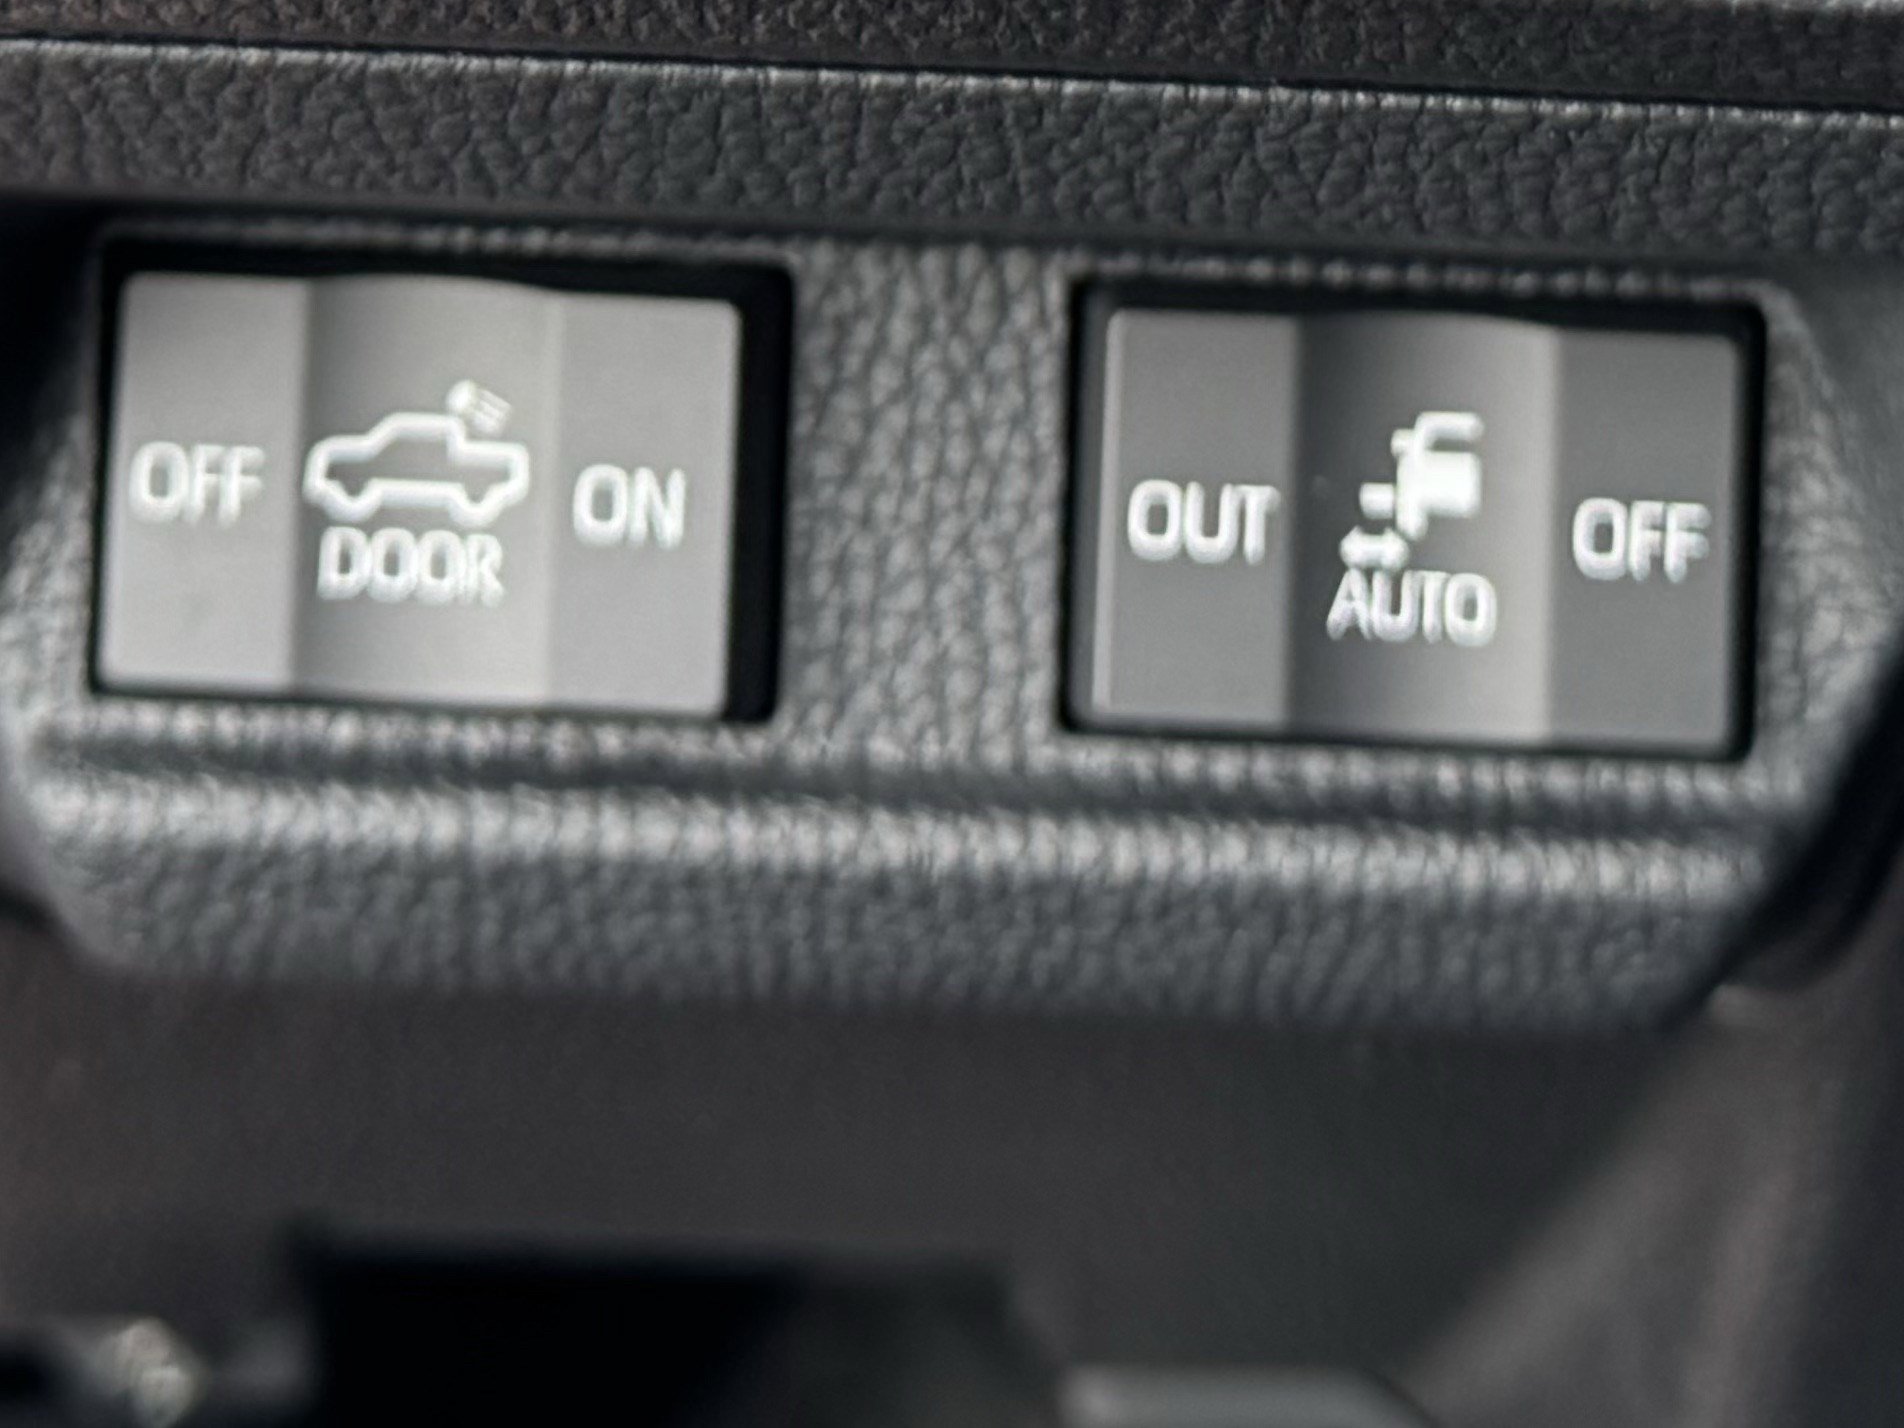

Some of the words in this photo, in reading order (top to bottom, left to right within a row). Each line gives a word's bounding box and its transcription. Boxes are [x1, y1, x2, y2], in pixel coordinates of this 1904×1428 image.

[129, 442, 265, 523] OFF
[573, 464, 686, 548] ON
[1127, 480, 1280, 563] OUT
[317, 526, 503, 603] DOOR
[1572, 497, 1710, 582] OFF
[1327, 568, 1496, 646] AUTO
